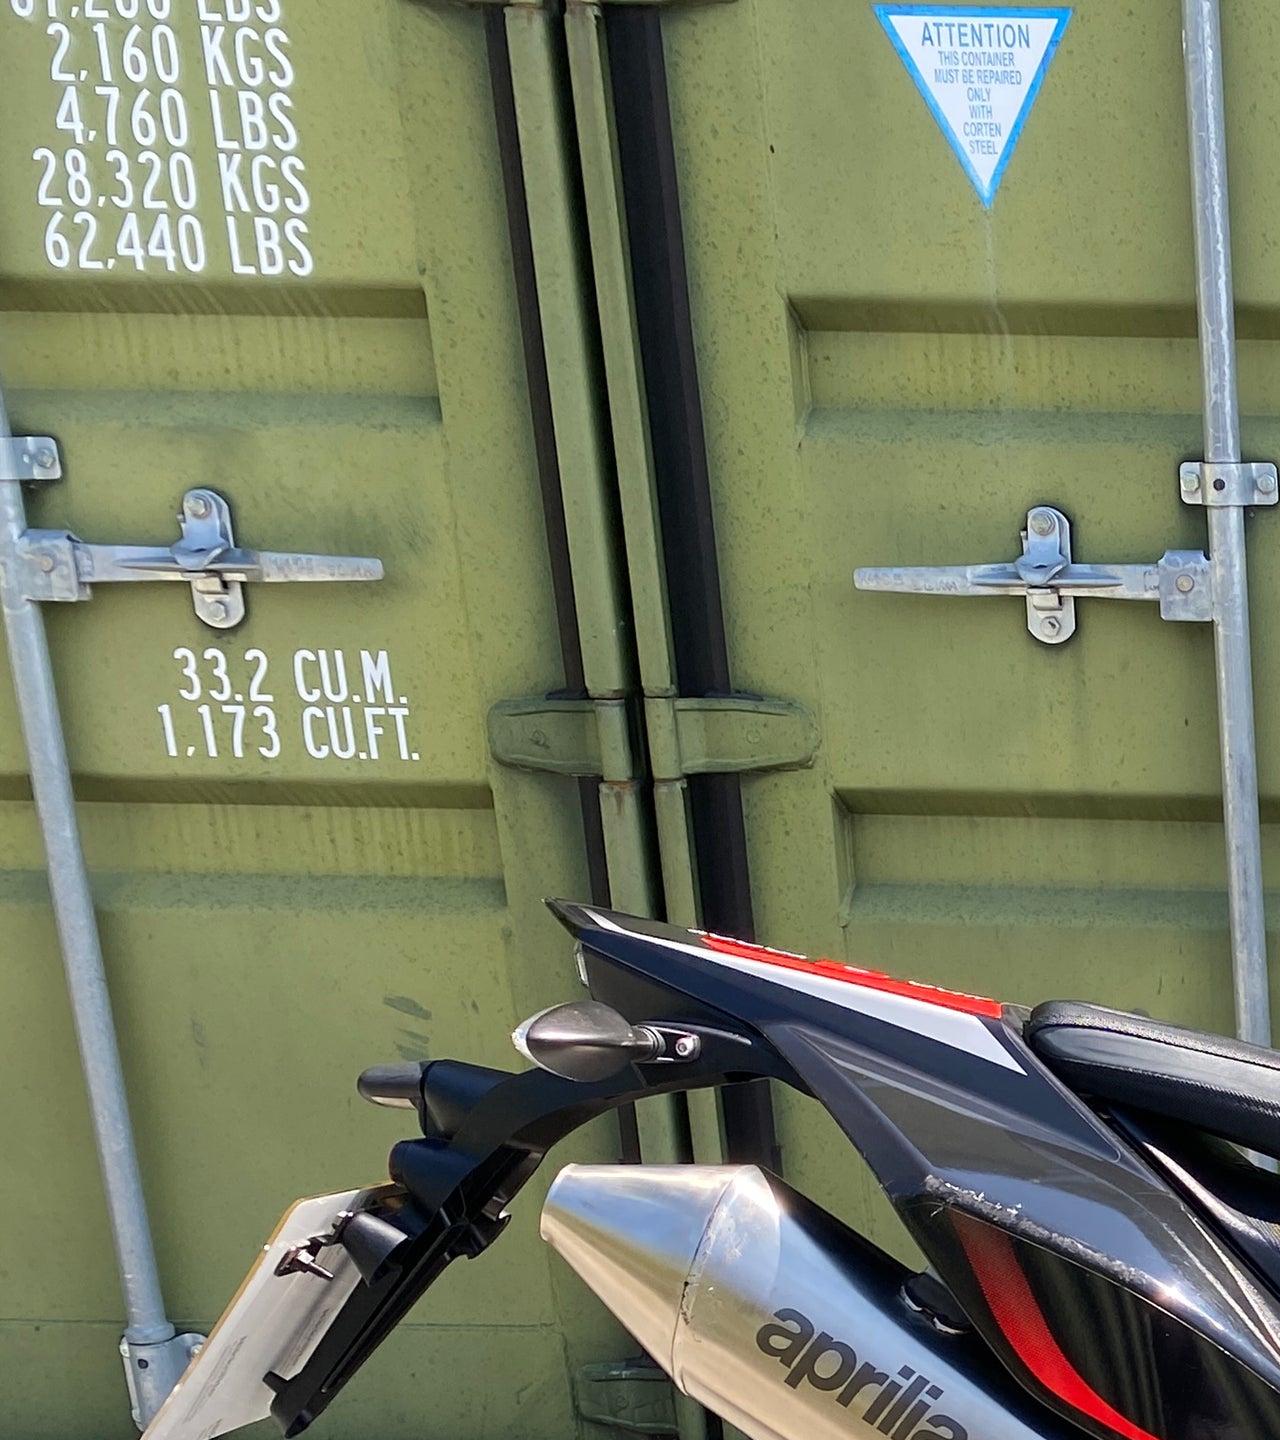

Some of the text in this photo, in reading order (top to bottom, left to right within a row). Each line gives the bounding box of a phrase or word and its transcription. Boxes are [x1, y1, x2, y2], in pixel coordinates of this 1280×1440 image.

[920, 21, 1032, 49] ATTENTION
[46, 22, 295, 88] 2,160 KGS
[938, 51, 1016, 68] THIS CONTAINER
[934, 68, 1023, 86] MUST BE REPAIRED
[966, 87, 992, 103] ONLY
[55, 85, 299, 152] 4,760 LBS
[968, 104, 994, 120] WITH
[962, 121, 1002, 138] CORTEN
[968, 139, 999, 156] STEEL
[32, 147, 311, 215] 28,320 KGS
[43, 210, 314, 277] 62,440 LBS
[172, 647, 409, 704] 33.2 CU.M.
[157, 703, 421, 761] 1,173 CU.FT.
